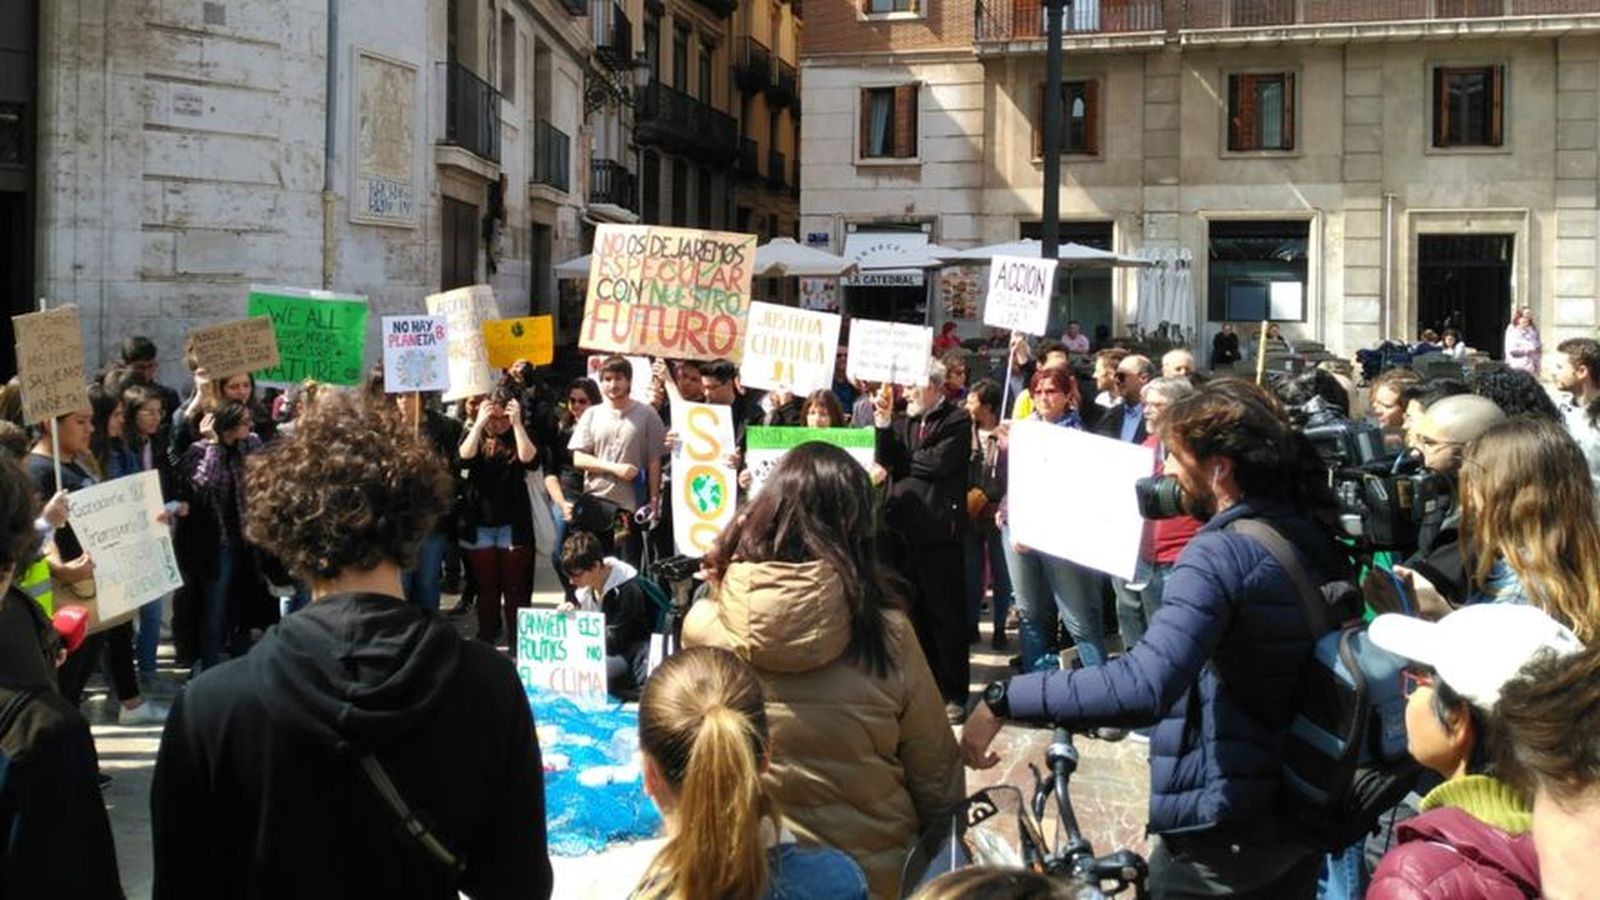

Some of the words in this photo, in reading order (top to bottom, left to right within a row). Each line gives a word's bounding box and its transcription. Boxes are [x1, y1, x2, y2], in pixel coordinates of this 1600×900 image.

[602, 232, 625, 257] NO
[627, 234, 647, 257] OS
[650, 235, 745, 265] DEJAREMOS
[599, 255, 744, 292] ESPECULAR
[596, 277, 643, 305] CON
[649, 280, 742, 315] NUESTRO
[267, 305, 301, 326] WE
[305, 308, 343, 330] ALL
[393, 320, 409, 334] NO
[411, 319, 434, 333] HAY
[588, 299, 738, 356] FUTURO
[388, 333, 437, 348] PLANETA
[435, 324, 445, 340] B
[587, 645, 602, 661] NO
[550, 667, 602, 697] CLIMA
